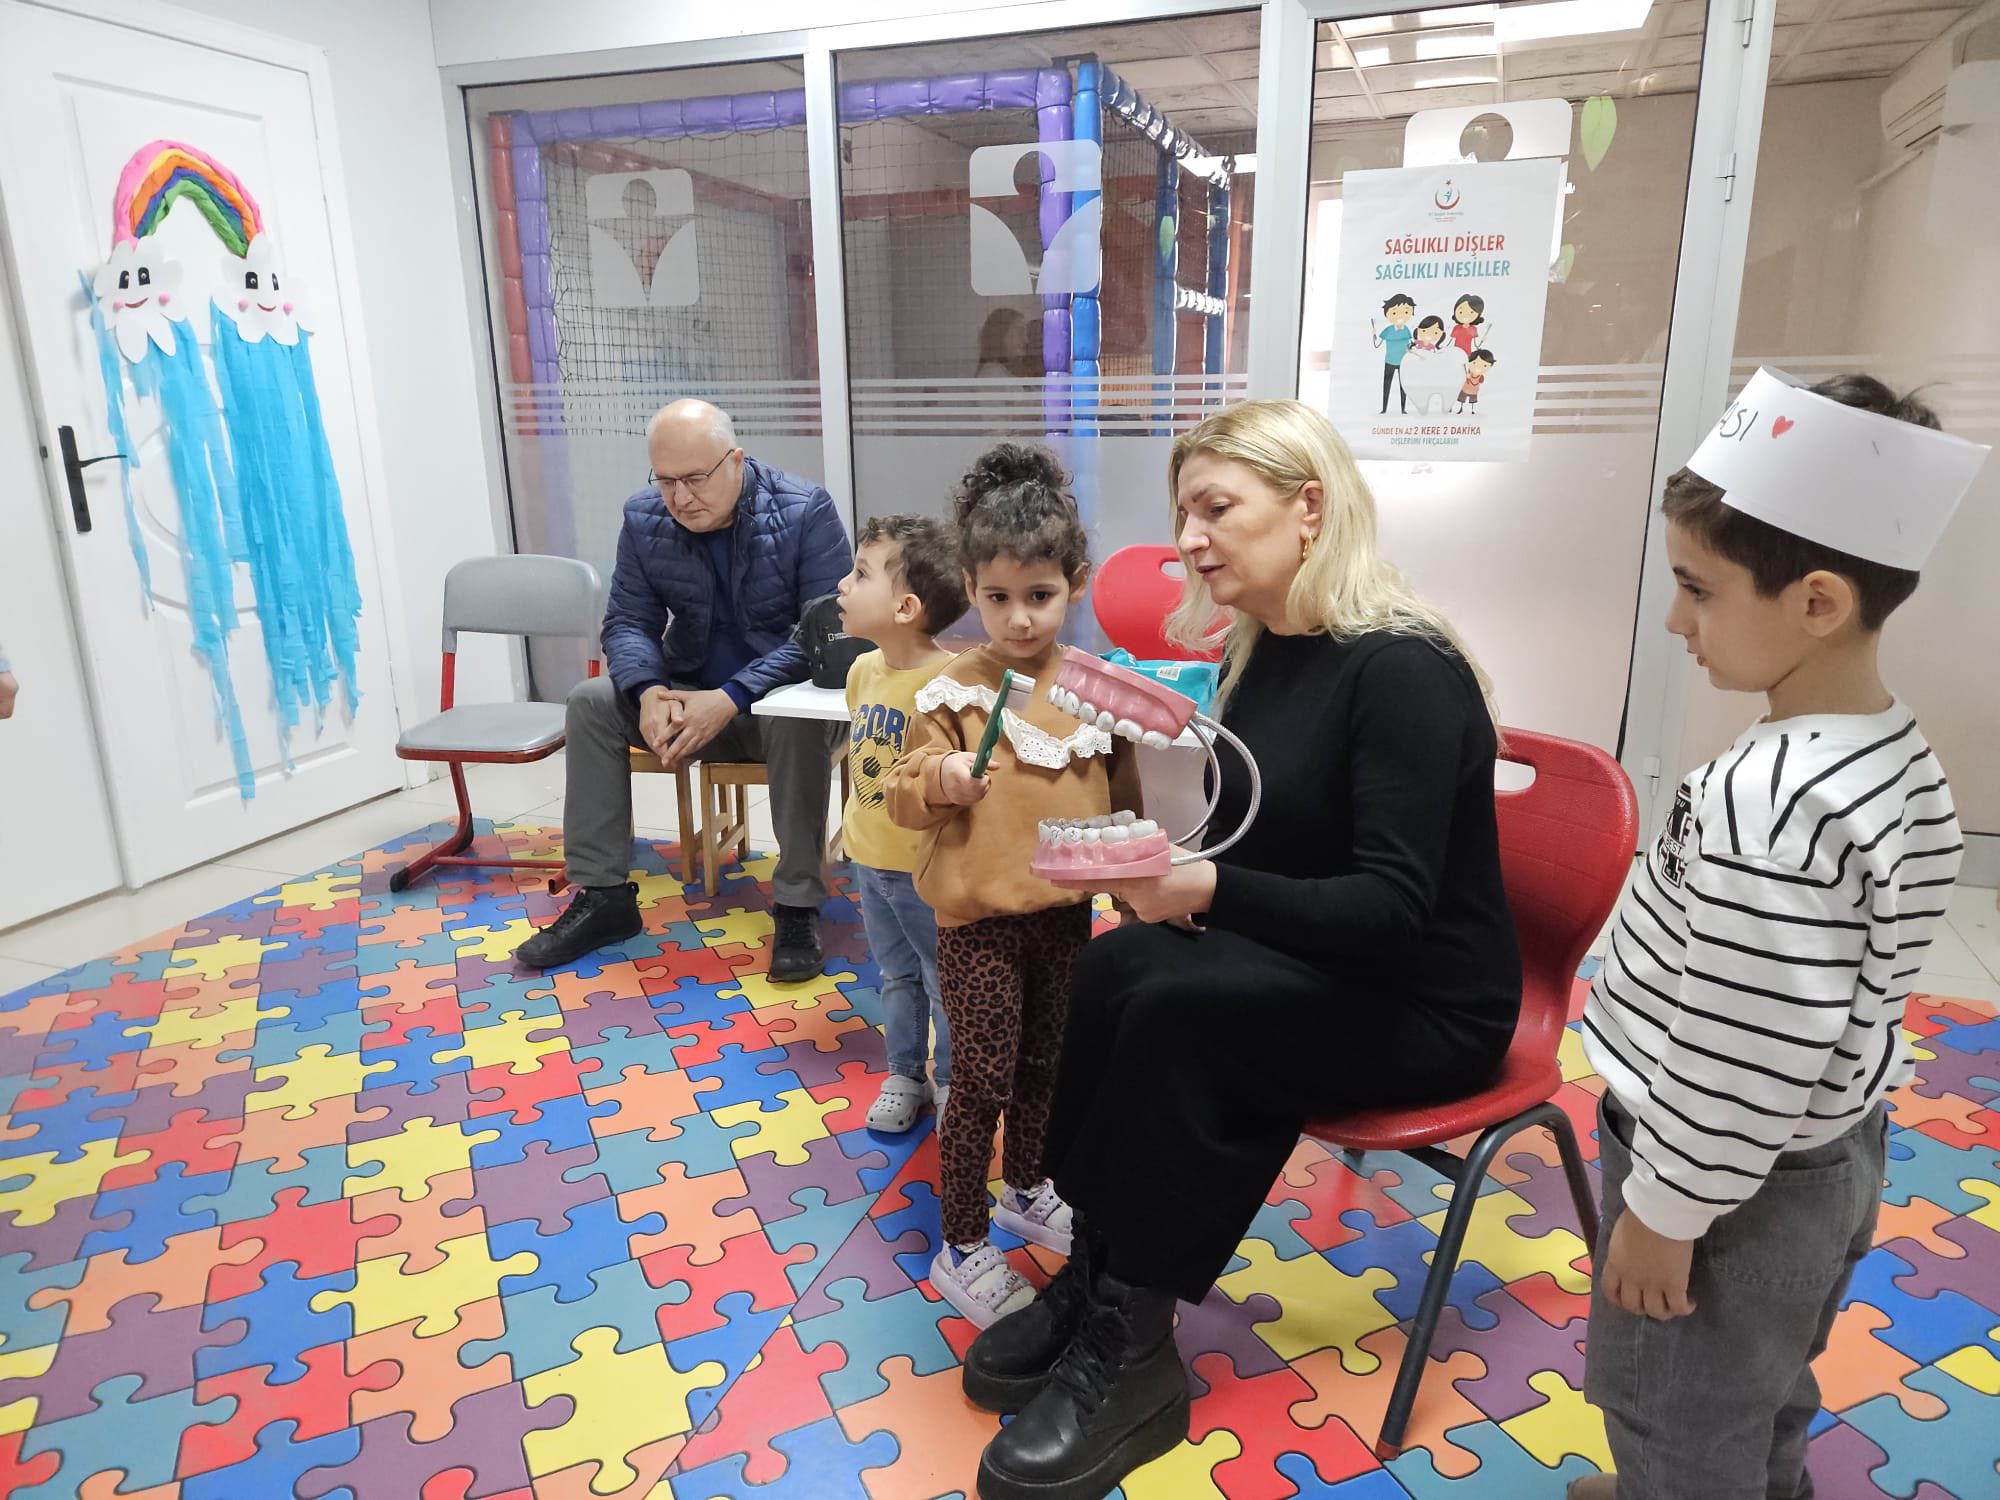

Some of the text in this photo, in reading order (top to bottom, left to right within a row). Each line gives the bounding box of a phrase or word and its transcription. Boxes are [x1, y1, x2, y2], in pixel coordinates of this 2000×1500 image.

[1385, 231, 1505, 257] SAĞLIKLI DİŞLER
[1375, 257, 1511, 281] SAĞLIKLI NESİLLER
[1414, 426, 1419, 435] 2
[1421, 426, 1441, 435] KERE
[1443, 426, 1448, 435] 2
[1450, 424, 1481, 435] DAKİKA
[852, 704, 911, 753] COR
